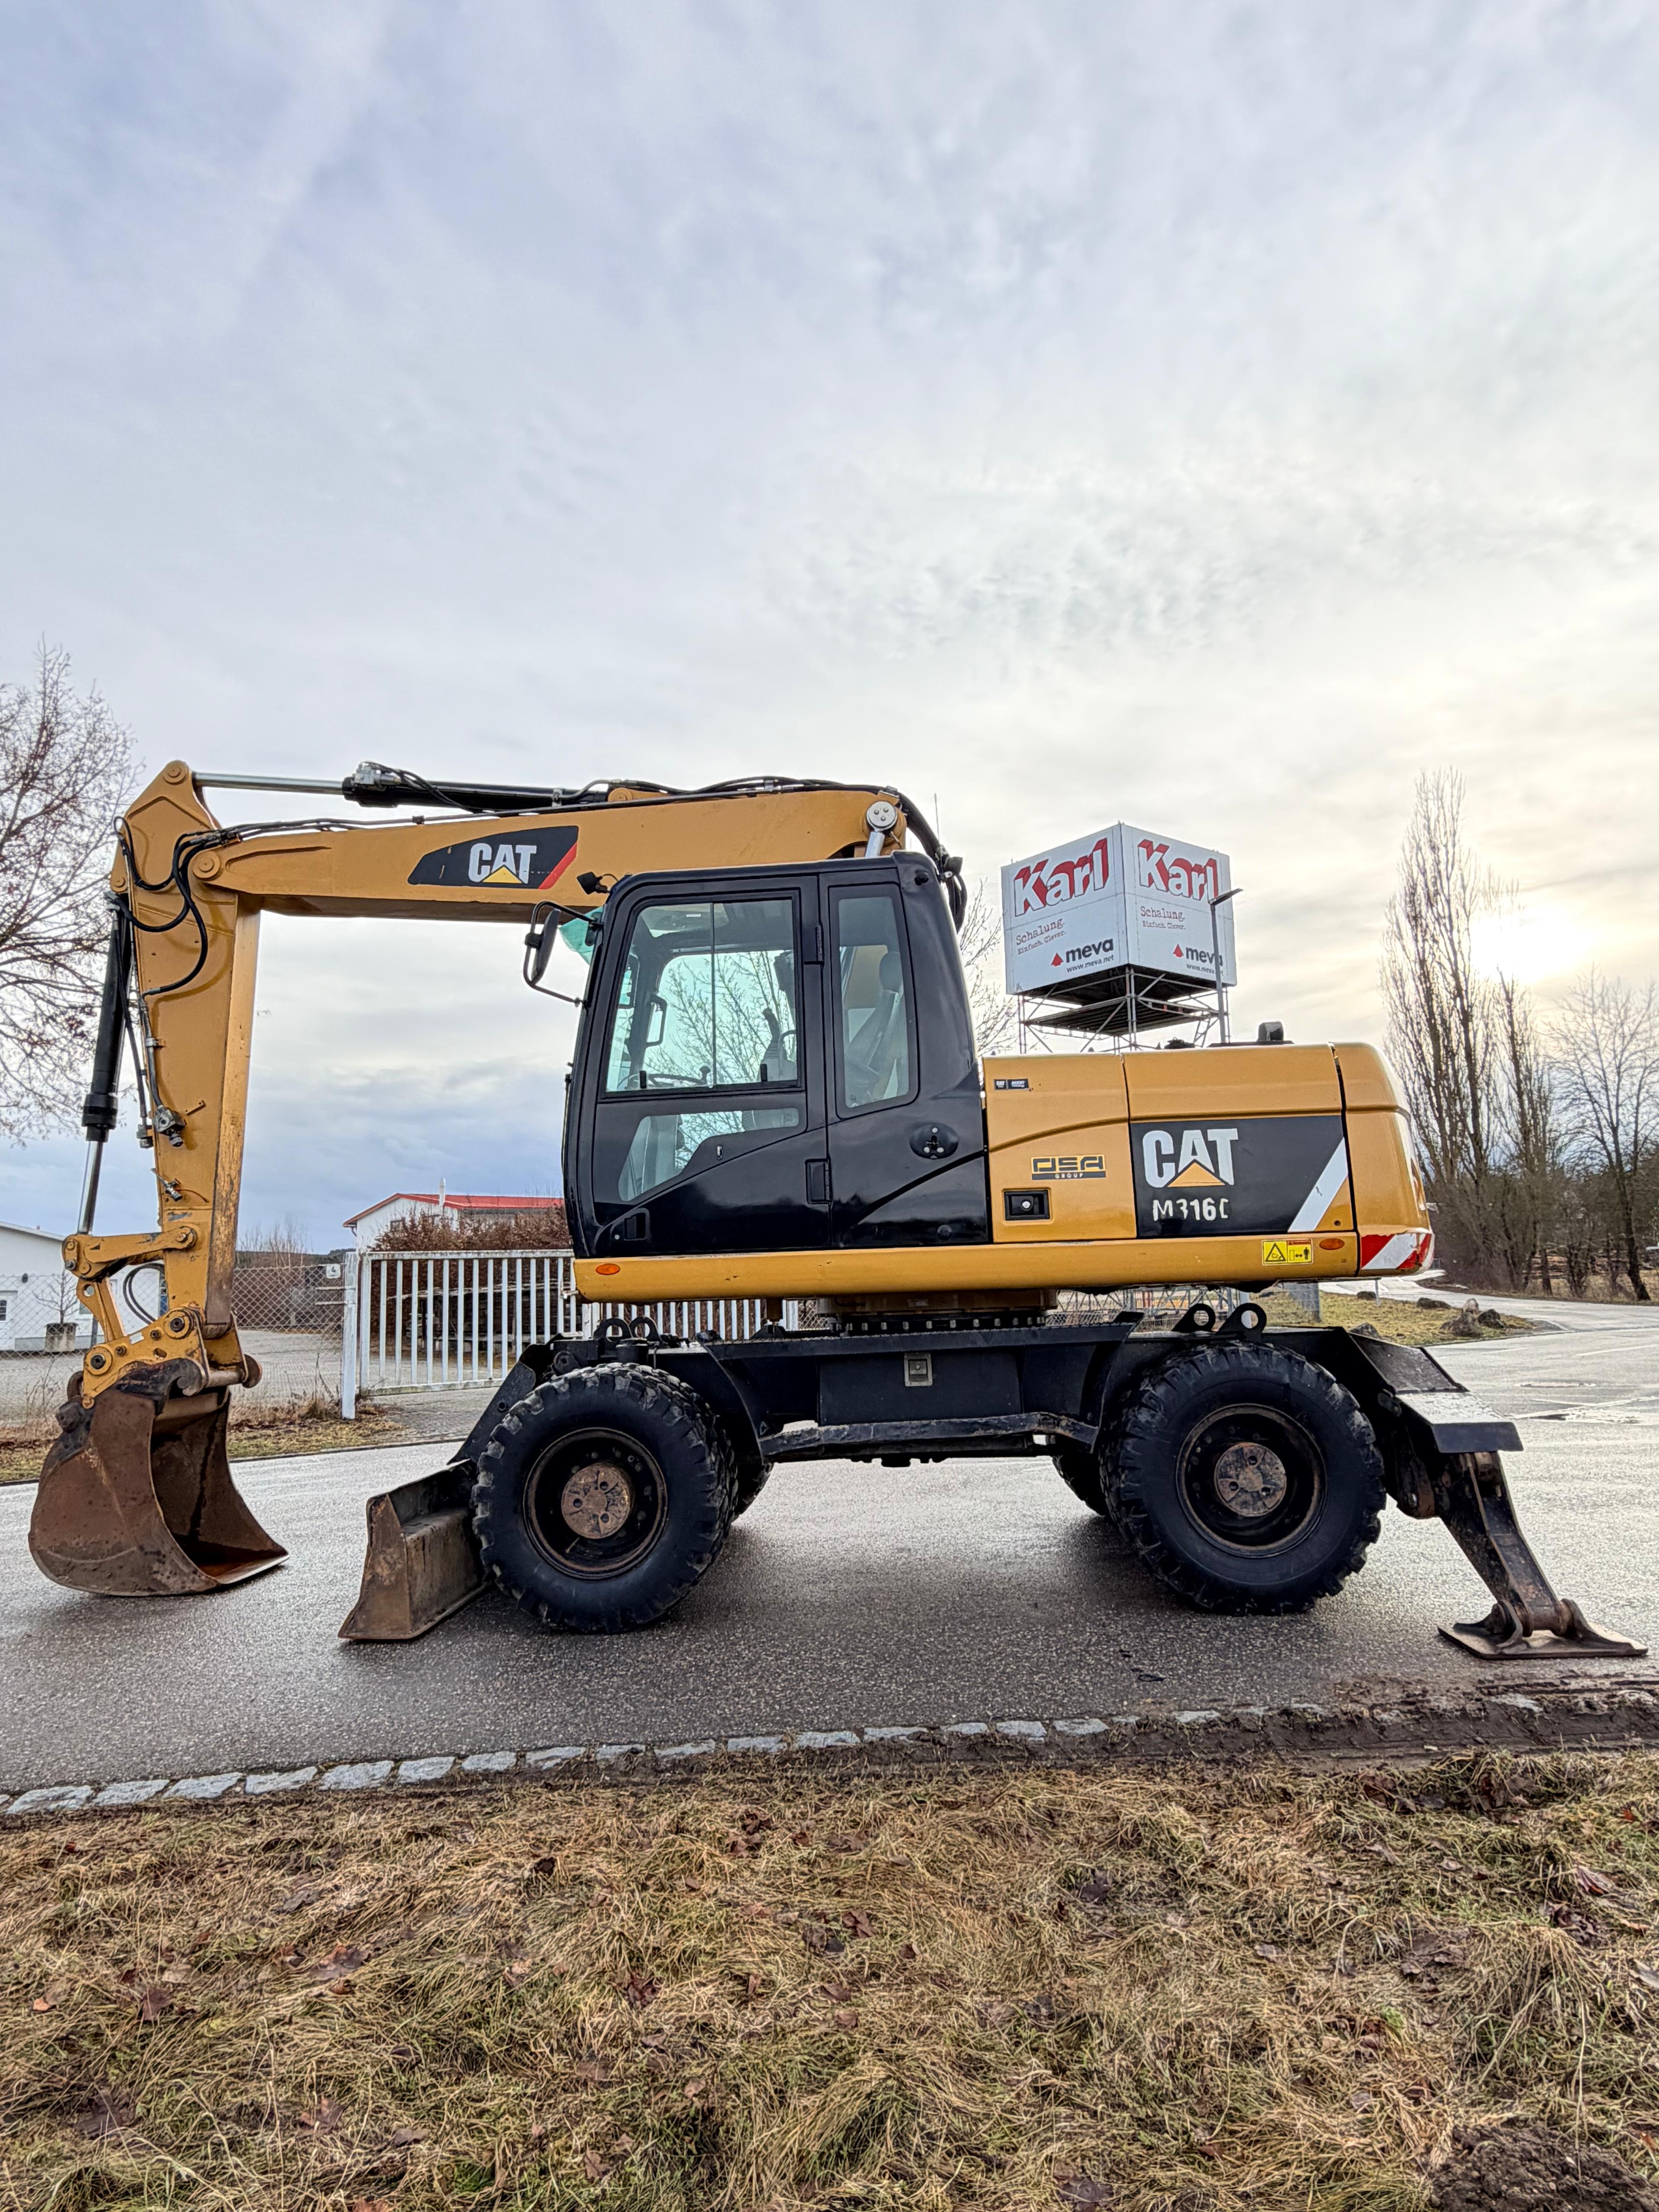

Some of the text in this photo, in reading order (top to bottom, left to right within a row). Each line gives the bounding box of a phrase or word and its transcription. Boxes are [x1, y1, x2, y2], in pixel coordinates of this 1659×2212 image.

[468, 843, 537, 884] CAT
[1014, 838, 1109, 917] Karl
[1138, 839, 1219, 904] Karl
[1141, 906, 1185, 922] Schalung.
[1016, 918, 1065, 945] Schalung.
[1066, 938, 1113, 963] meva
[1066, 954, 1114, 973] www.meva.net
[1142, 1128, 1239, 1188] CAT
